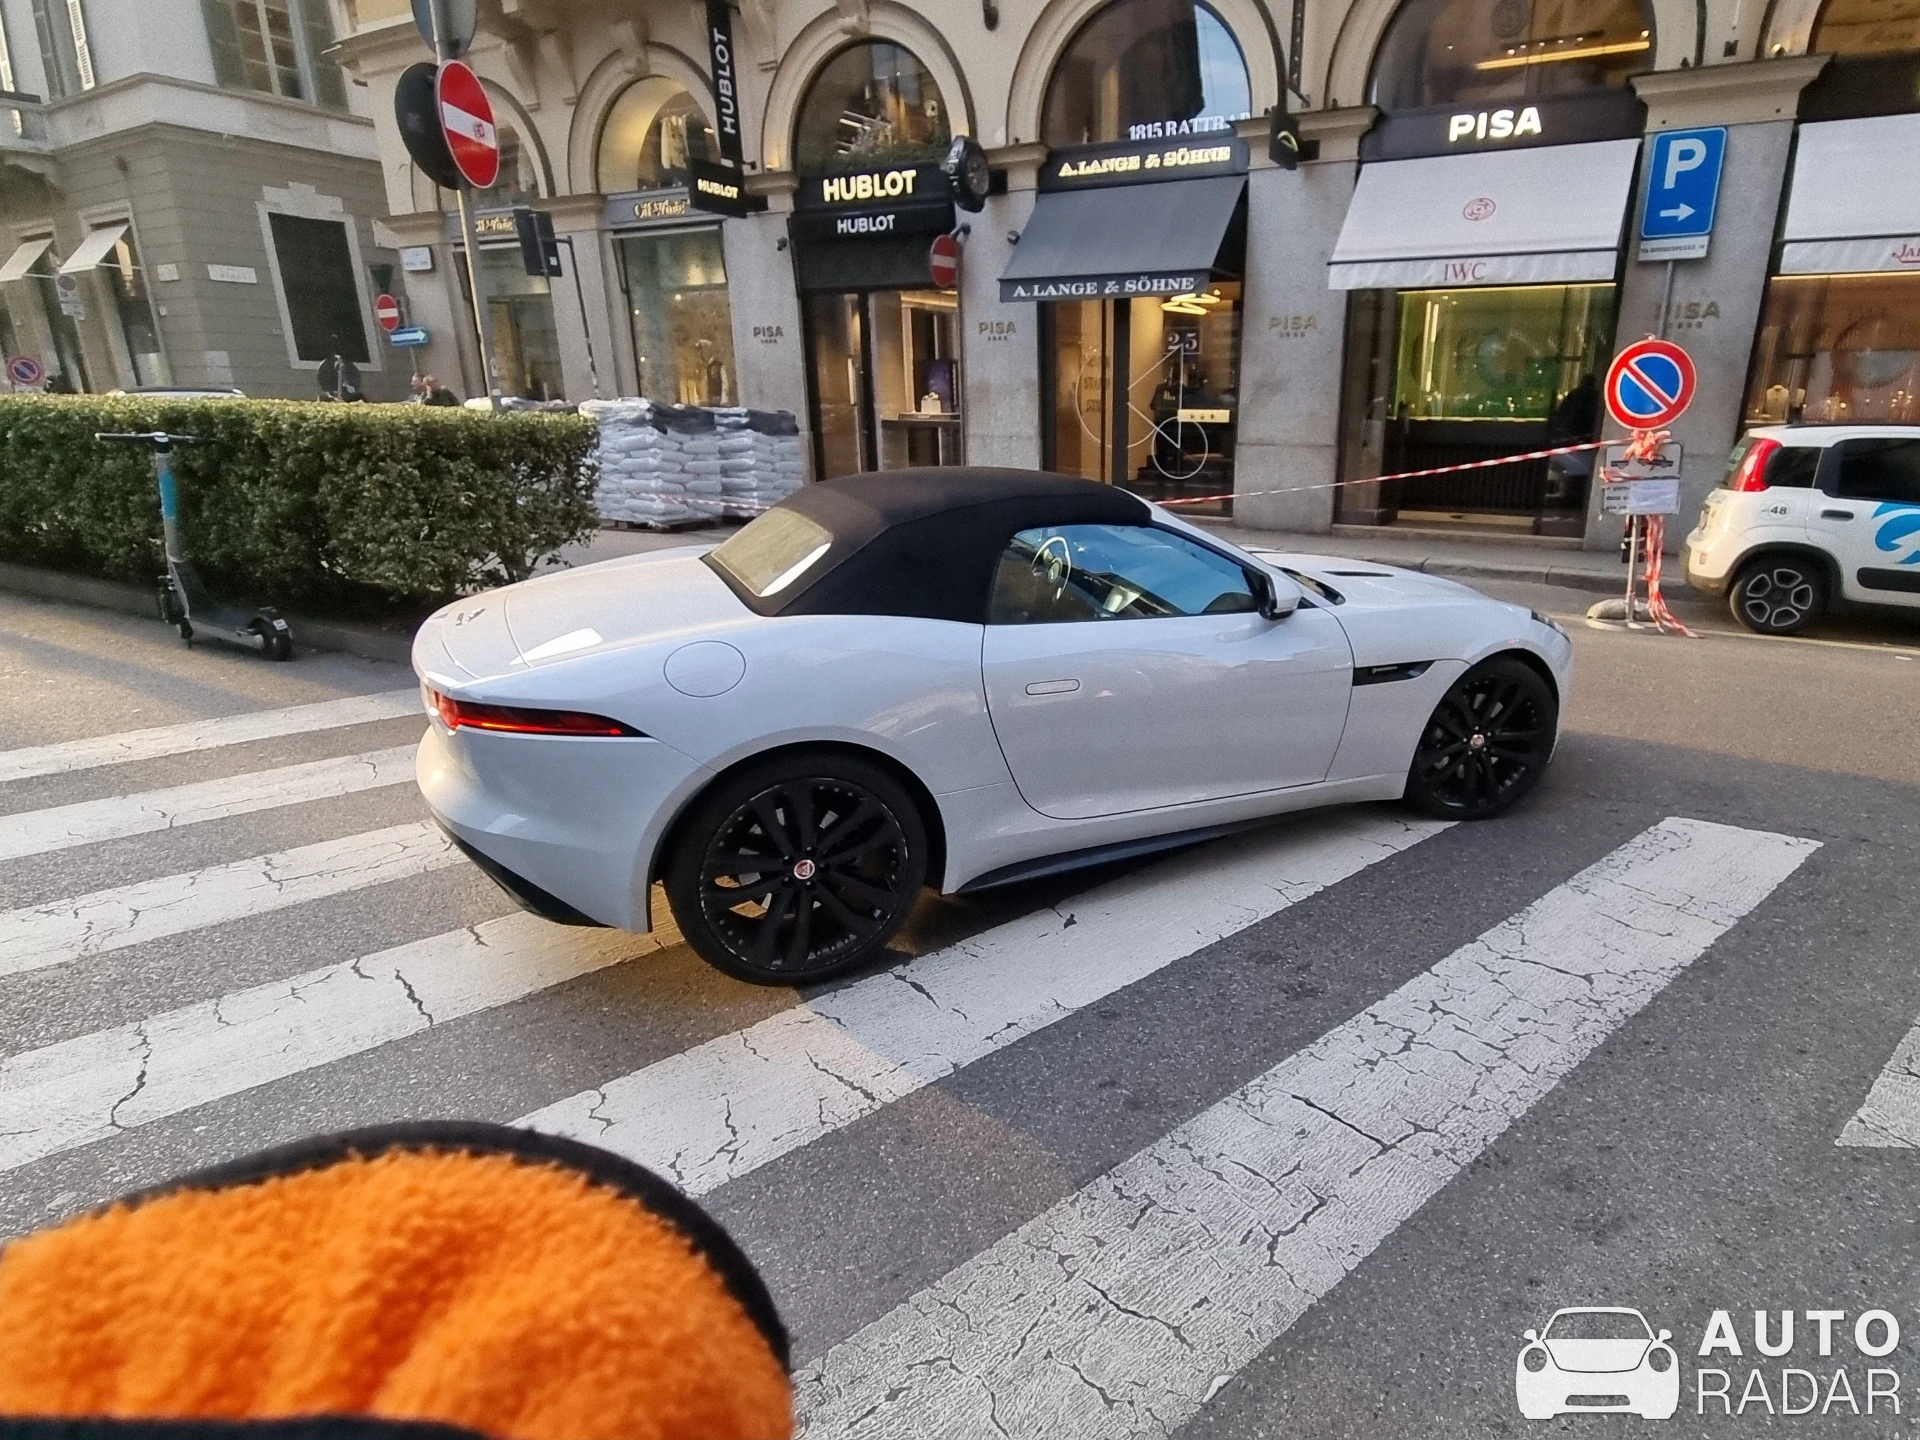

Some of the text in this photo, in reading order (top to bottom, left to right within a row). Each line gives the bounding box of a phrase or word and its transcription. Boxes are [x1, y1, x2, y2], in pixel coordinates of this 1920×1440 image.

[712, 28, 737, 135] HUBLOT
[1128, 121, 1163, 141] 1815
[1448, 106, 1543, 143] PISA
[1144, 153, 1160, 170] &
[1162, 146, 1231, 167] SÖHNE
[1662, 138, 1707, 190] P
[697, 178, 739, 199] HUBLOT
[822, 169, 918, 202] HUBLOT
[836, 214, 896, 235] HUBLOT
[1444, 262, 1487, 281] IWC
[1104, 281, 1120, 294] &
[1124, 275, 1195, 293] SÖHNE
[1656, 301, 1721, 321] ISA
[753, 325, 784, 337] PISA
[979, 321, 1017, 335] PISA
[1268, 313, 1318, 330] PISA
[1167, 332, 1198, 350] 25
[1769, 505, 1788, 516] 48
